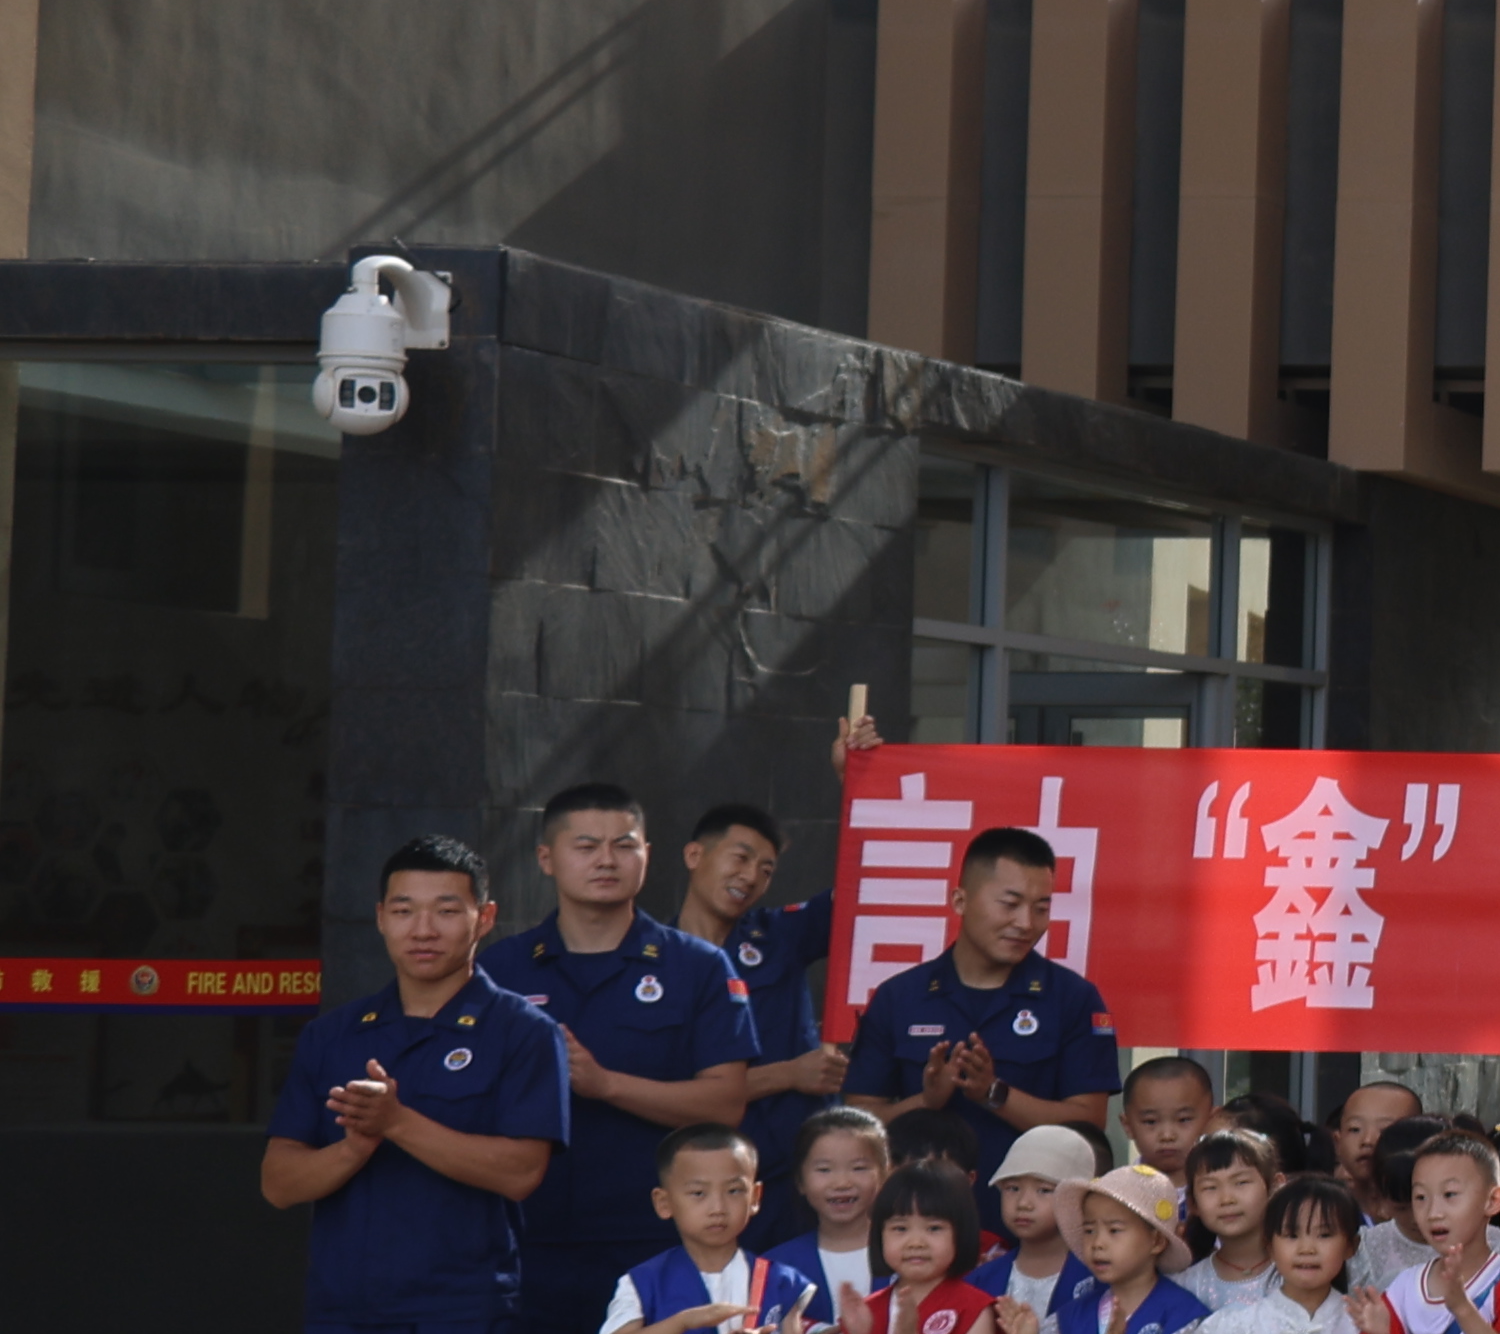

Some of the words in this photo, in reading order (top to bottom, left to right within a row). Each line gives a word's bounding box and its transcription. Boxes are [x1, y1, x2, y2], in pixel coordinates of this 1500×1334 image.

[0, 970, 100, 993] 救援
[187, 972, 227, 994] FIRE
[232, 972, 274, 994] AND
